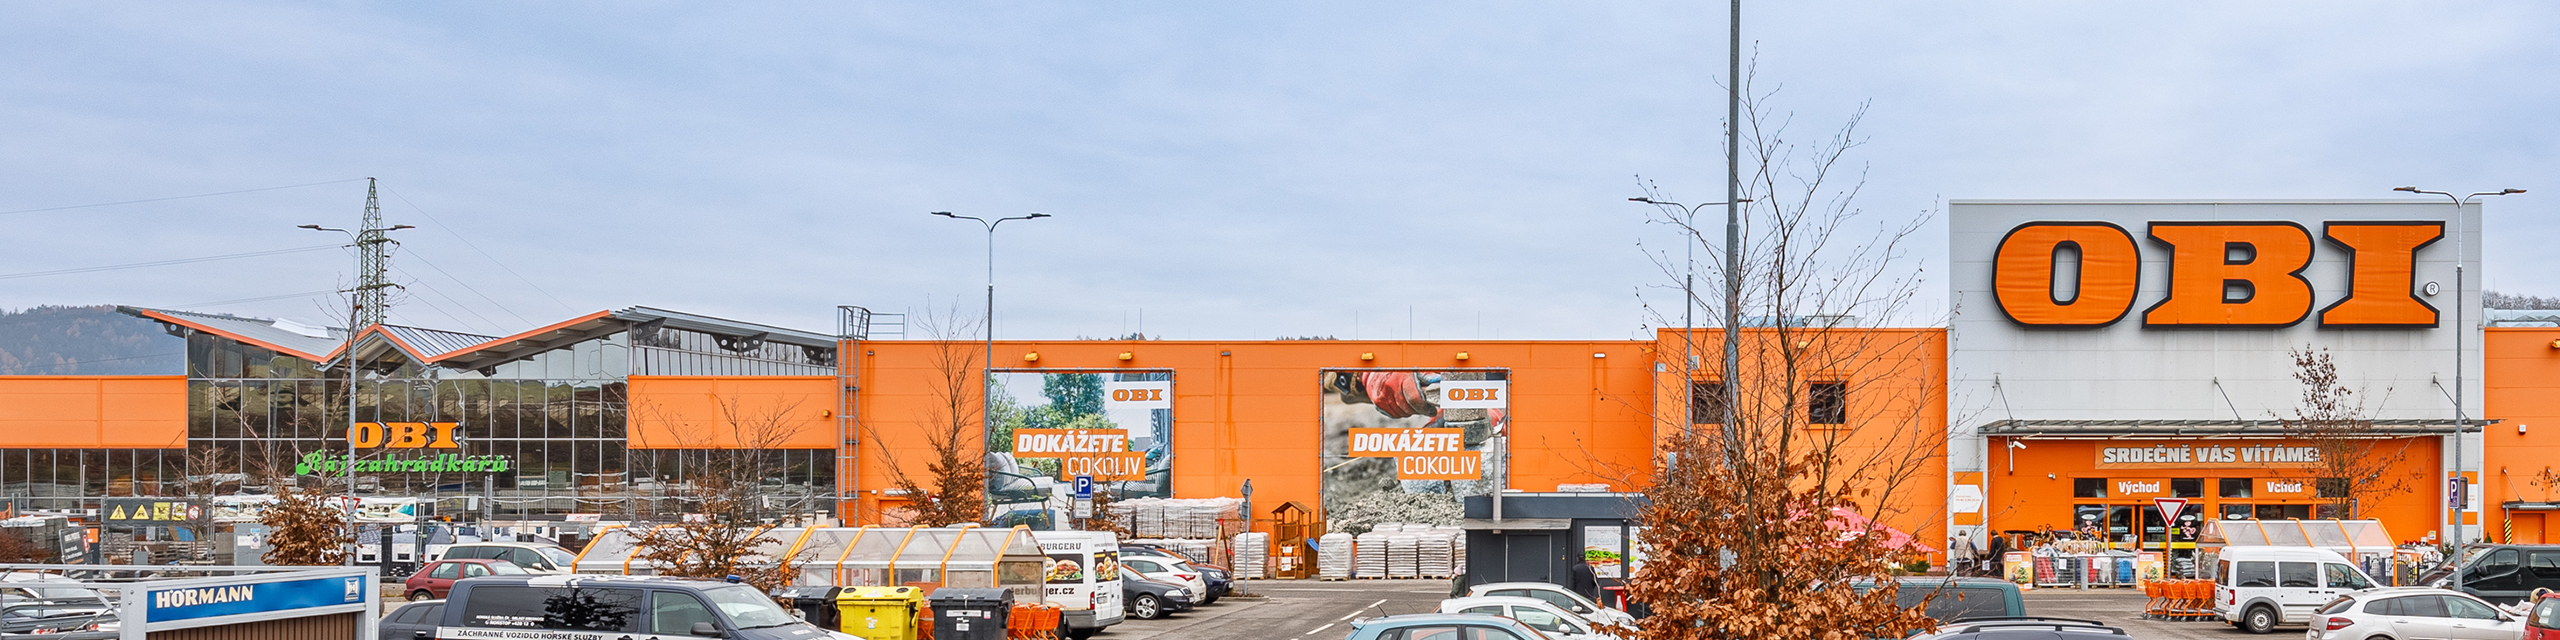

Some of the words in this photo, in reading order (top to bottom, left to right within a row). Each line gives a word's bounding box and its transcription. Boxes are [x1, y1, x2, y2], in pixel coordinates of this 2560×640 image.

[1991, 220, 2446, 329] OBI
[1112, 389, 1163, 402] OBI
[1448, 388, 1499, 401] OBI
[346, 422, 460, 449] OBI
[1017, 430, 1124, 453] DOKÁŽETE
[1353, 429, 1460, 452] DOKÁŽETE
[355, 453, 506, 473] zahrádkářů
[2103, 444, 2191, 463] SRDEČNĚ
[2196, 444, 2236, 463] VÁS
[1067, 456, 1141, 476] COKOLIV
[1402, 456, 1477, 475] COKOLIV
[1078, 478, 1089, 492] P
[2118, 481, 2160, 496] Východ
[2266, 481, 2302, 493] Vchod
[2450, 481, 2457, 499] P
[1040, 542, 1081, 551] BURGERU
[156, 585, 254, 609] HÖRMANN
[457, 630, 504, 639] ZÁCHRANNÉ
[506, 632, 539, 640] VOZIDLO
[541, 632, 572, 640] HORSKÉ
